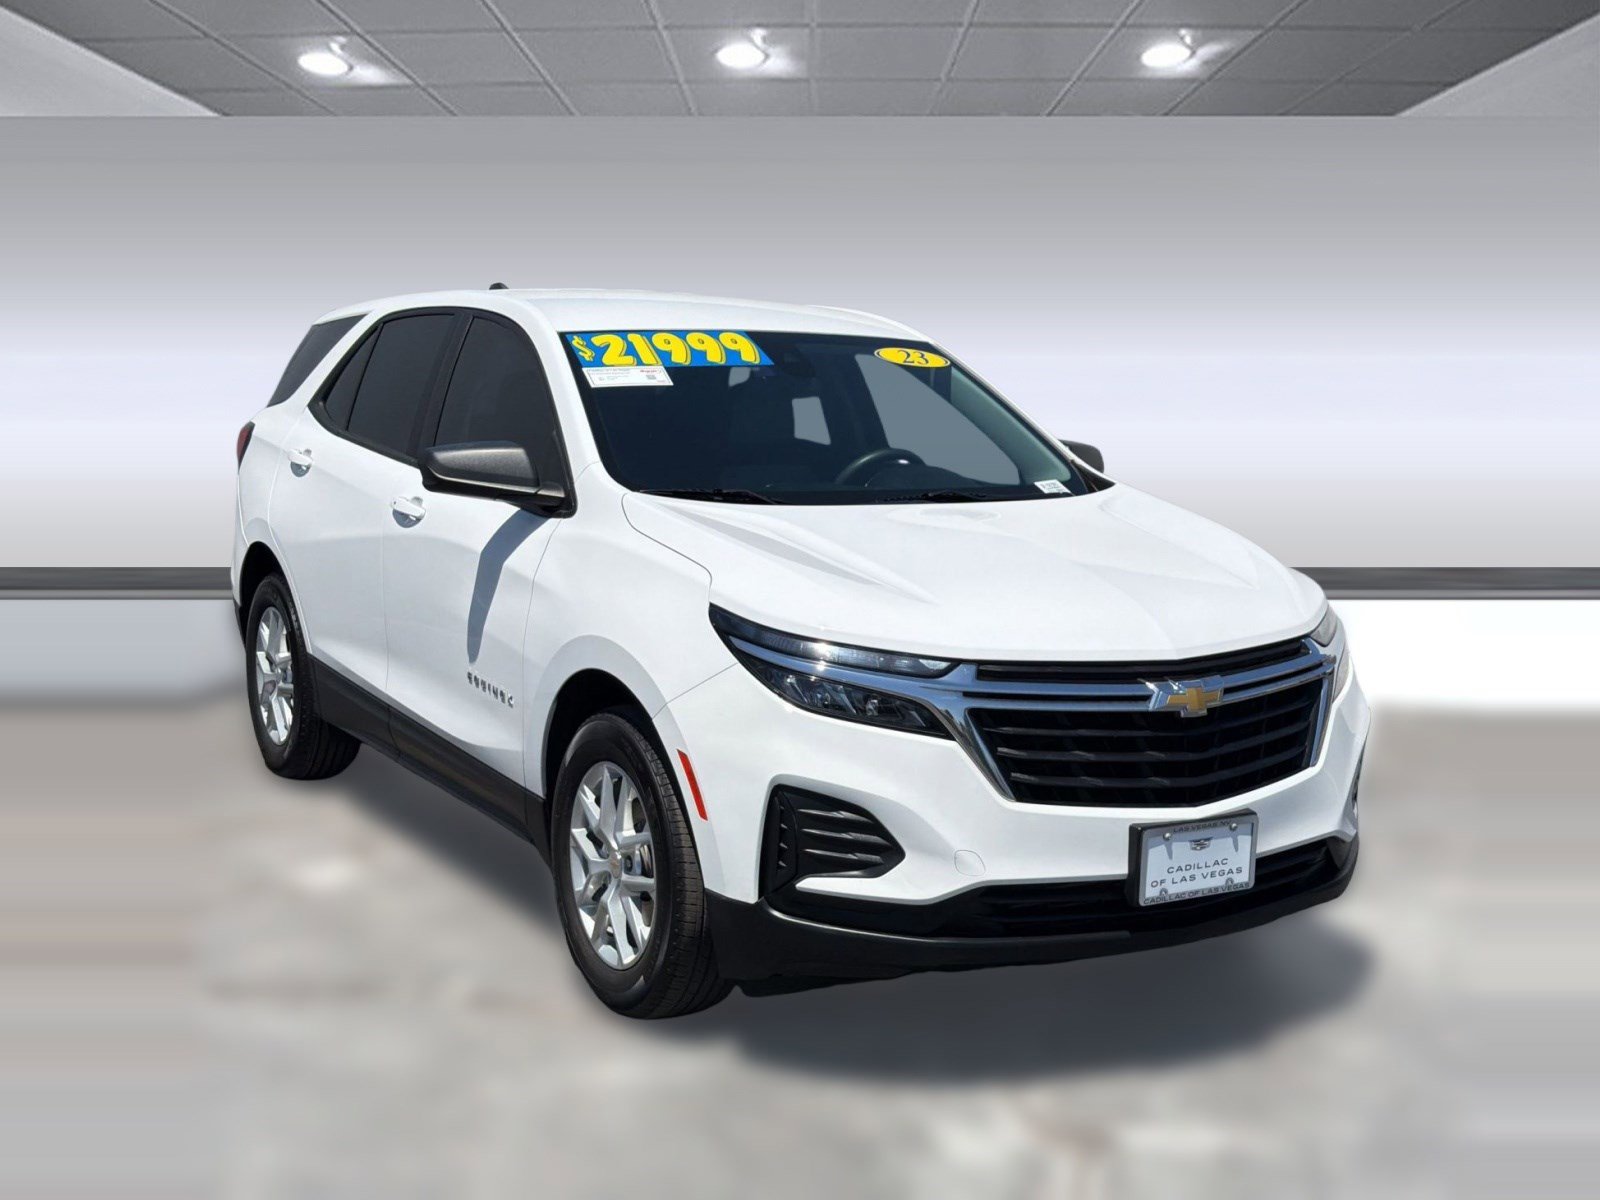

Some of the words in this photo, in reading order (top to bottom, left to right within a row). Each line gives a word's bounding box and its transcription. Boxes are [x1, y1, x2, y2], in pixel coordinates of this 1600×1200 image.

[572, 331, 761, 366] $21999
[898, 349, 929, 365] 23
[1173, 825, 1189, 833] LAS
[1191, 822, 1217, 832] VEGAS
[1167, 858, 1229, 874] CADILLAC
[1150, 879, 1167, 888] OF
[1172, 874, 1196, 885] LAS
[1201, 867, 1243, 879] VEGAS
[1143, 892, 1186, 905] CADILLAC
[1188, 890, 1201, 898] OF
[1202, 887, 1219, 897] LAS
[1221, 882, 1250, 892] VEGAS
